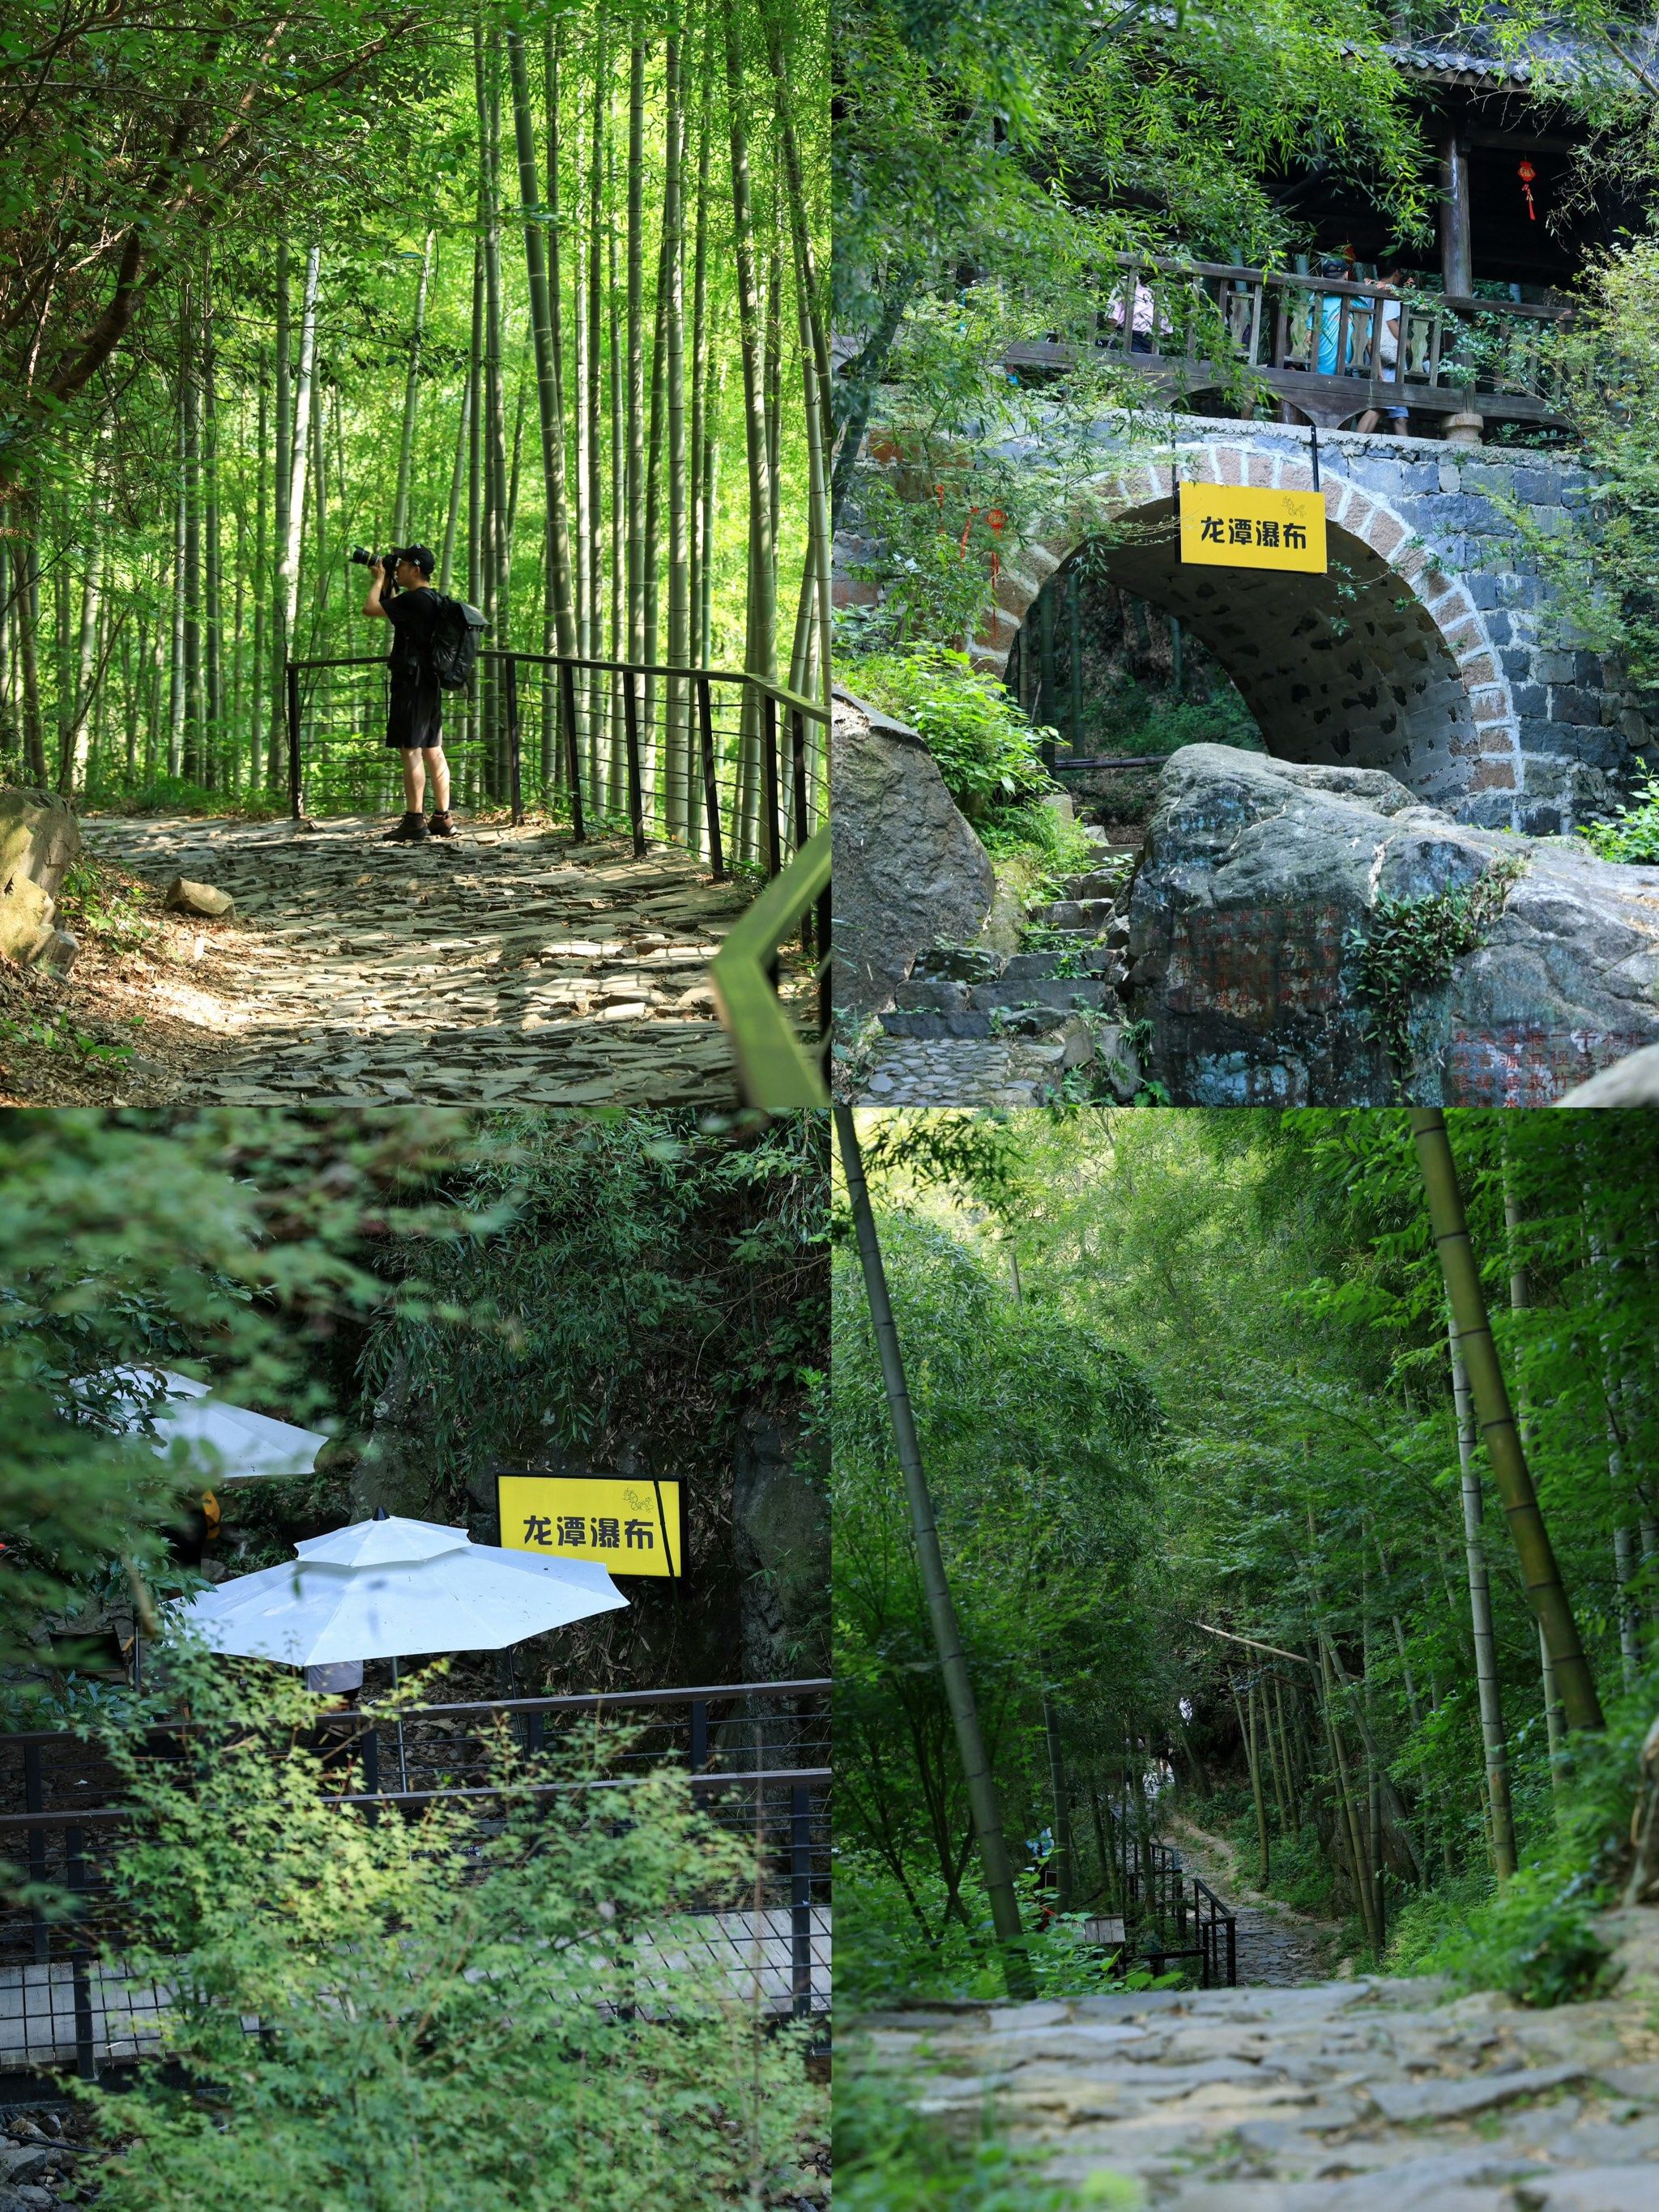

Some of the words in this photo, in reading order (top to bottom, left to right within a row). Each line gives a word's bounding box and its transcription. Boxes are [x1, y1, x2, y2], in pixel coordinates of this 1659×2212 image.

[1201, 516, 1307, 549] 龙潭瀑布
[522, 1515, 654, 1549] 龙潭瀑布
